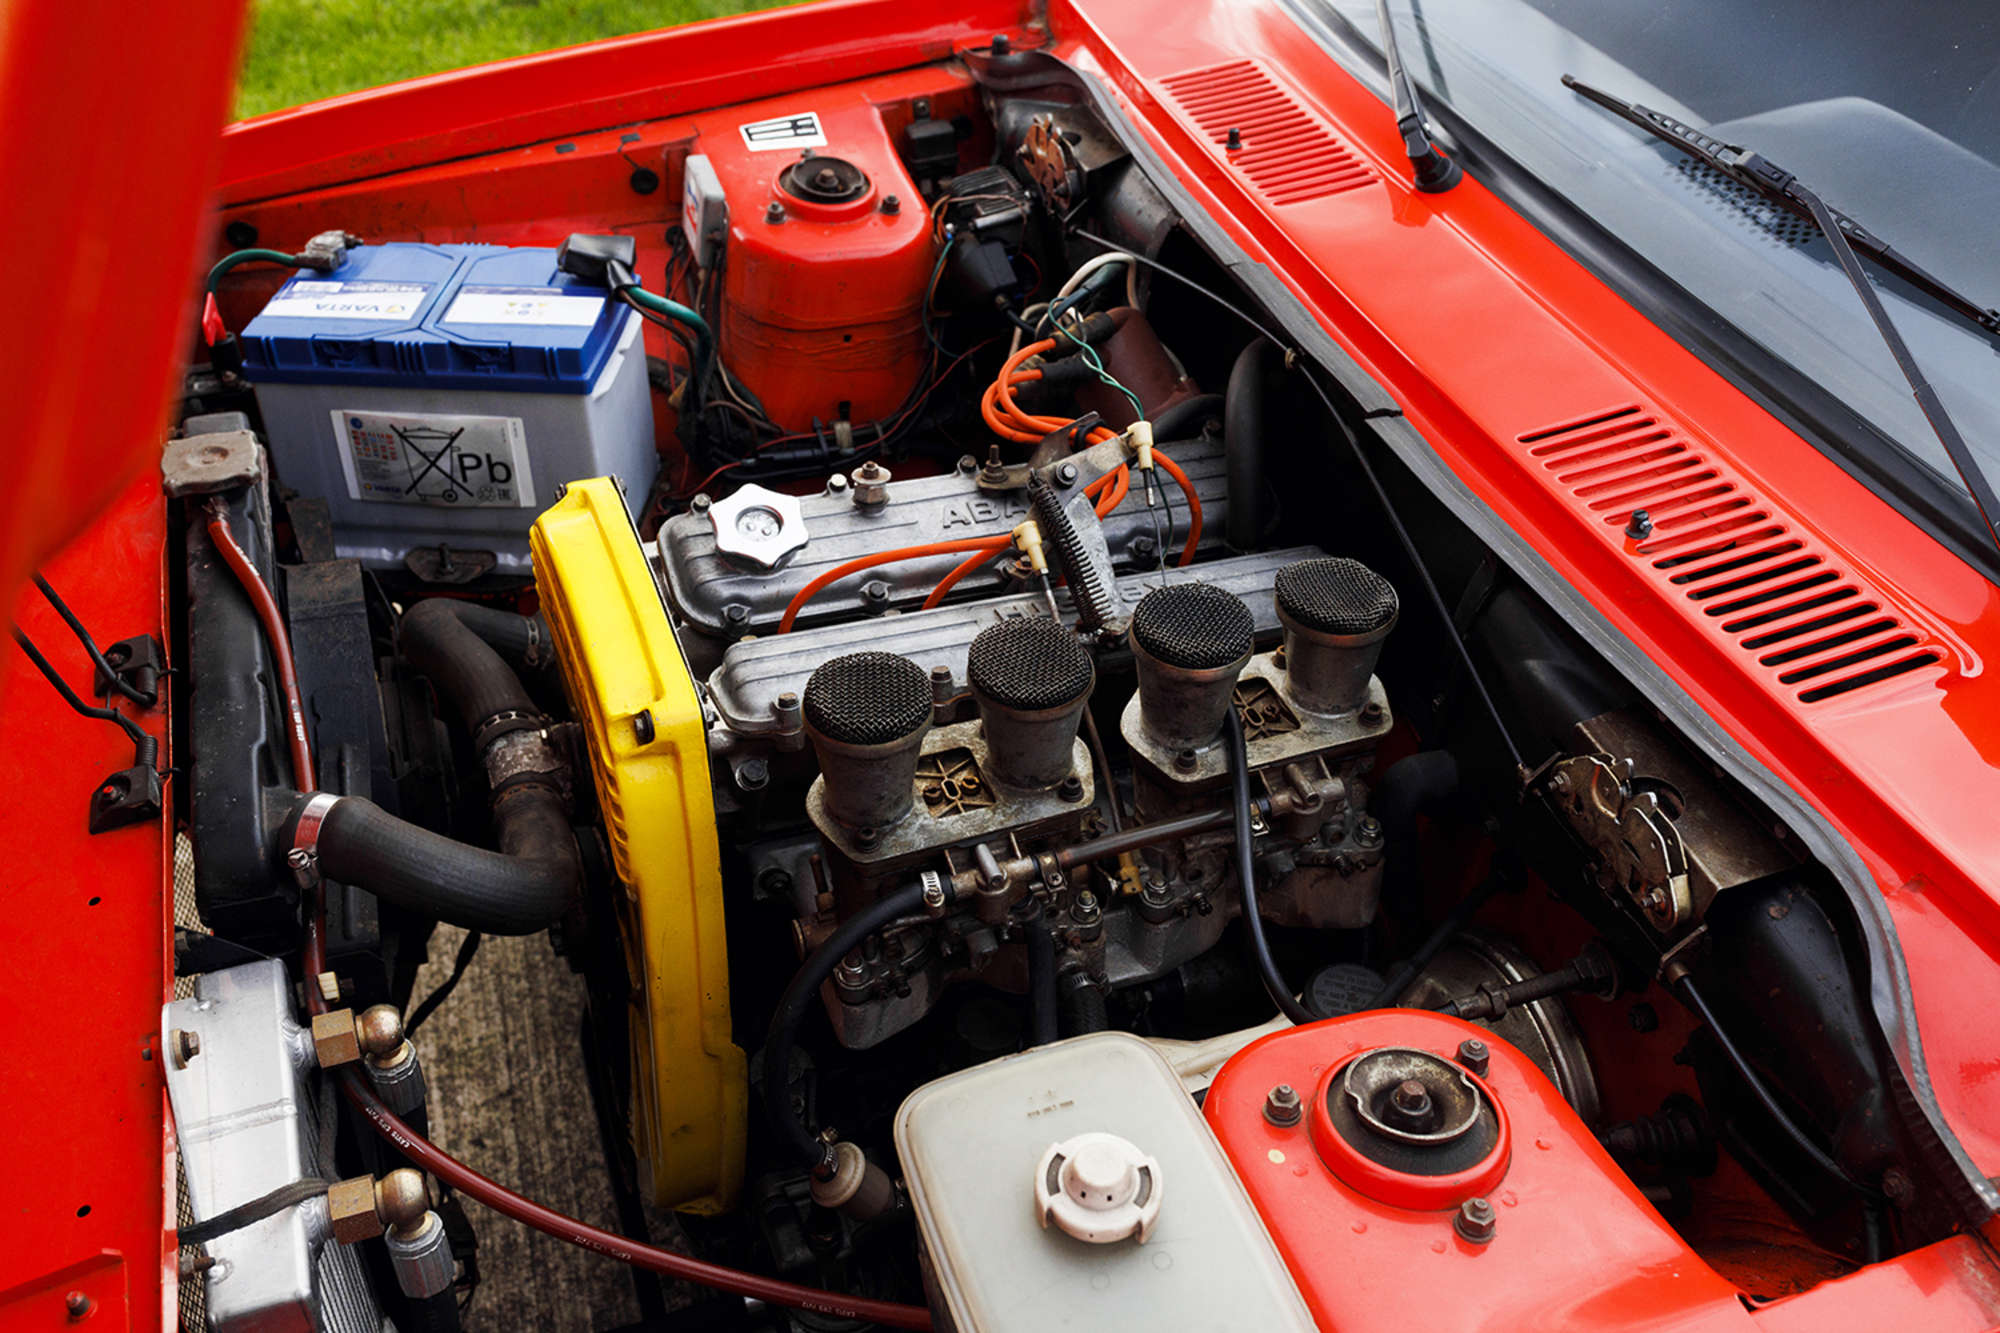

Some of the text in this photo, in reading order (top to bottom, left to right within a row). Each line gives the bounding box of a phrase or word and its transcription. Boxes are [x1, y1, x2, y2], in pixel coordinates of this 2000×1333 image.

[315, 303, 379, 312] VARTA
[457, 453, 512, 484] Pb
[943, 499, 1029, 529] ABA
